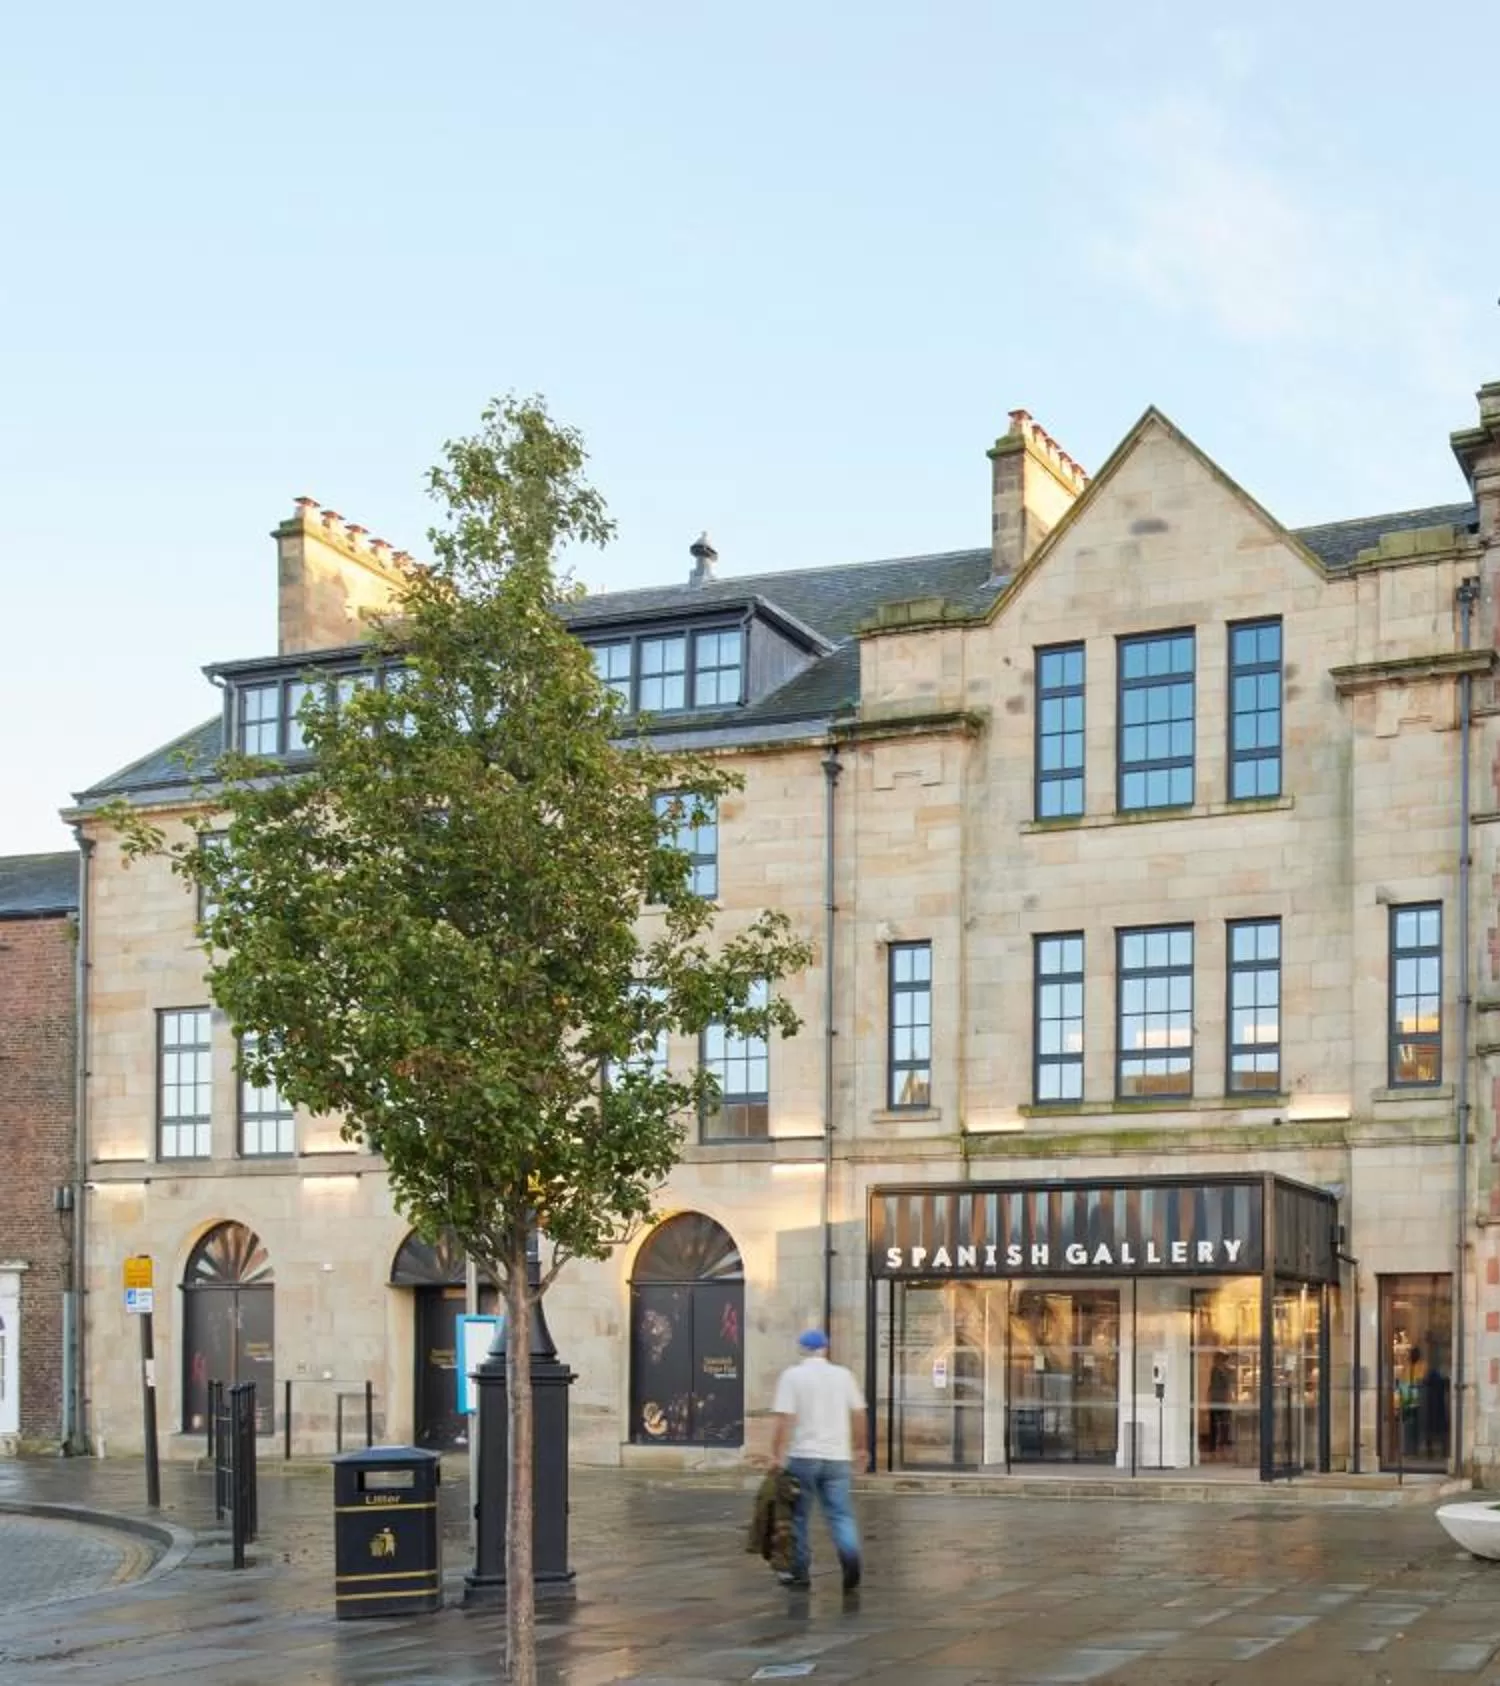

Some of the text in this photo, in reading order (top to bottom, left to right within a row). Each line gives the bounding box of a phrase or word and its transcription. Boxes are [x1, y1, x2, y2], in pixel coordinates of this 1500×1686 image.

[886, 1239, 1242, 1268] SPANISH GALLERY
[365, 1494, 401, 1505] Litter
